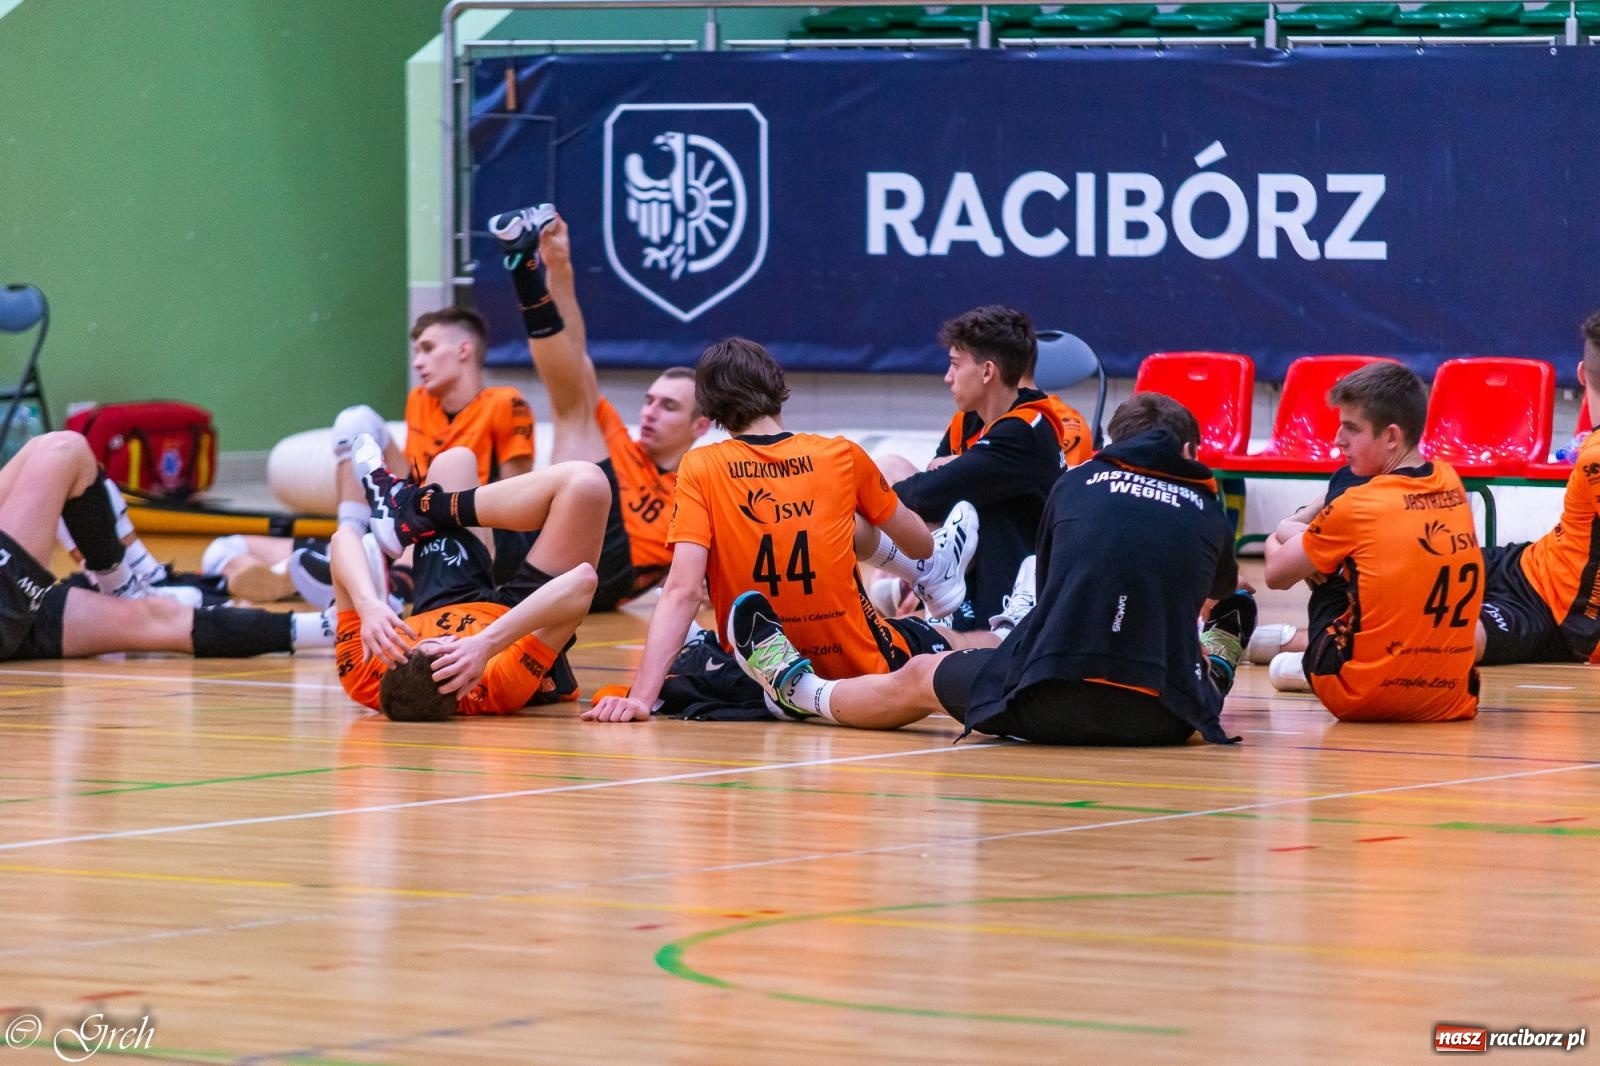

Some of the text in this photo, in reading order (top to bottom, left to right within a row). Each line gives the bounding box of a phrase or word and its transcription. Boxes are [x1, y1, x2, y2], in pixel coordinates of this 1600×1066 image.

[866, 140, 1388, 260] RACIBÓRZ
[728, 455, 814, 479] ŁUCZKOWSKI
[774, 499, 815, 524] JSW
[1110, 480, 1181, 508] WĘGIEL
[752, 529, 816, 597] 44
[1423, 562, 1479, 628] 42
